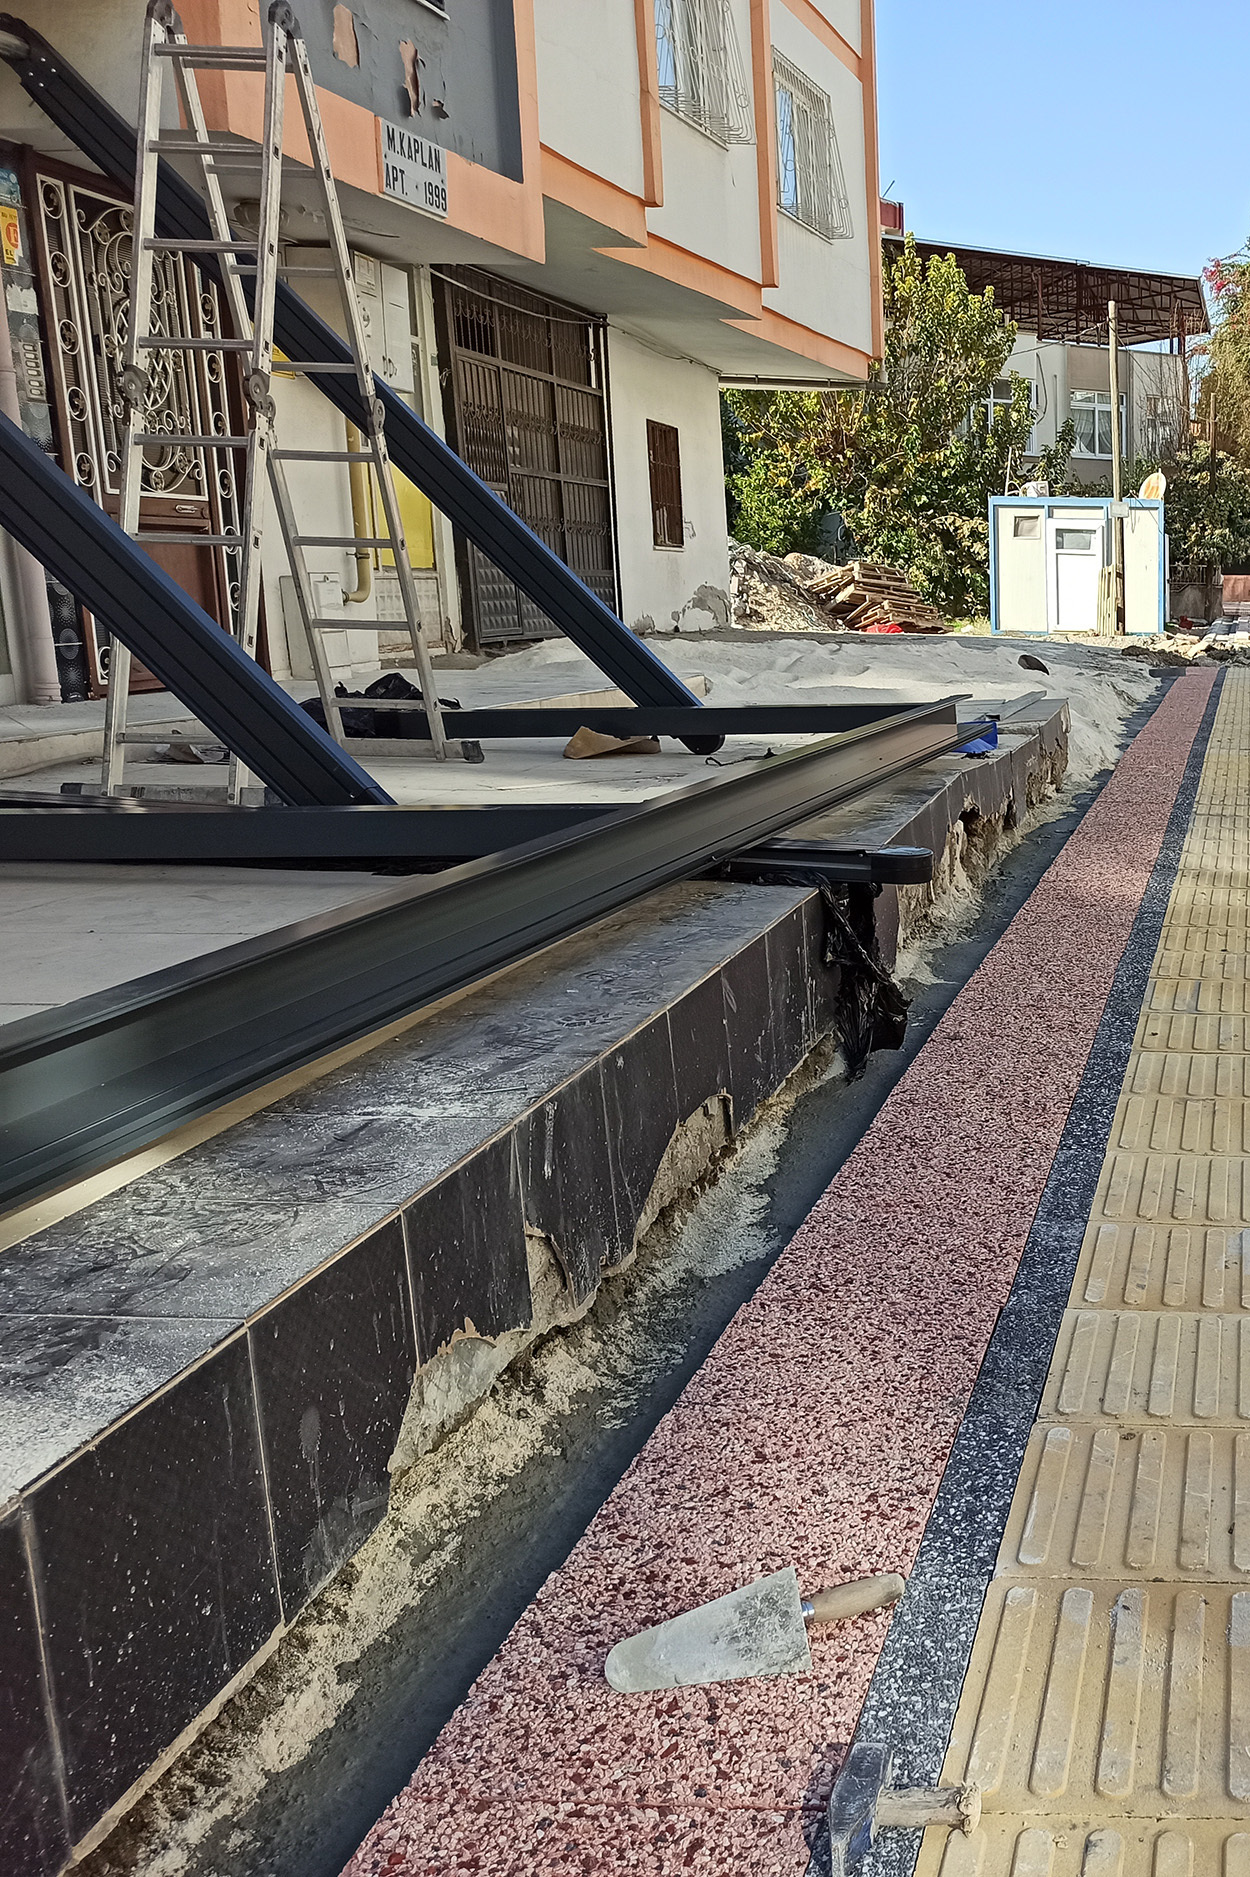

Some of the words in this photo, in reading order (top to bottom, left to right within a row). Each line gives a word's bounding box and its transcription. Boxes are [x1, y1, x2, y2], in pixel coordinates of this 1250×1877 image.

[386, 124, 442, 174] M.KAPLAN
[386, 163, 408, 196] APT.
[424, 180, 448, 213] 1999
